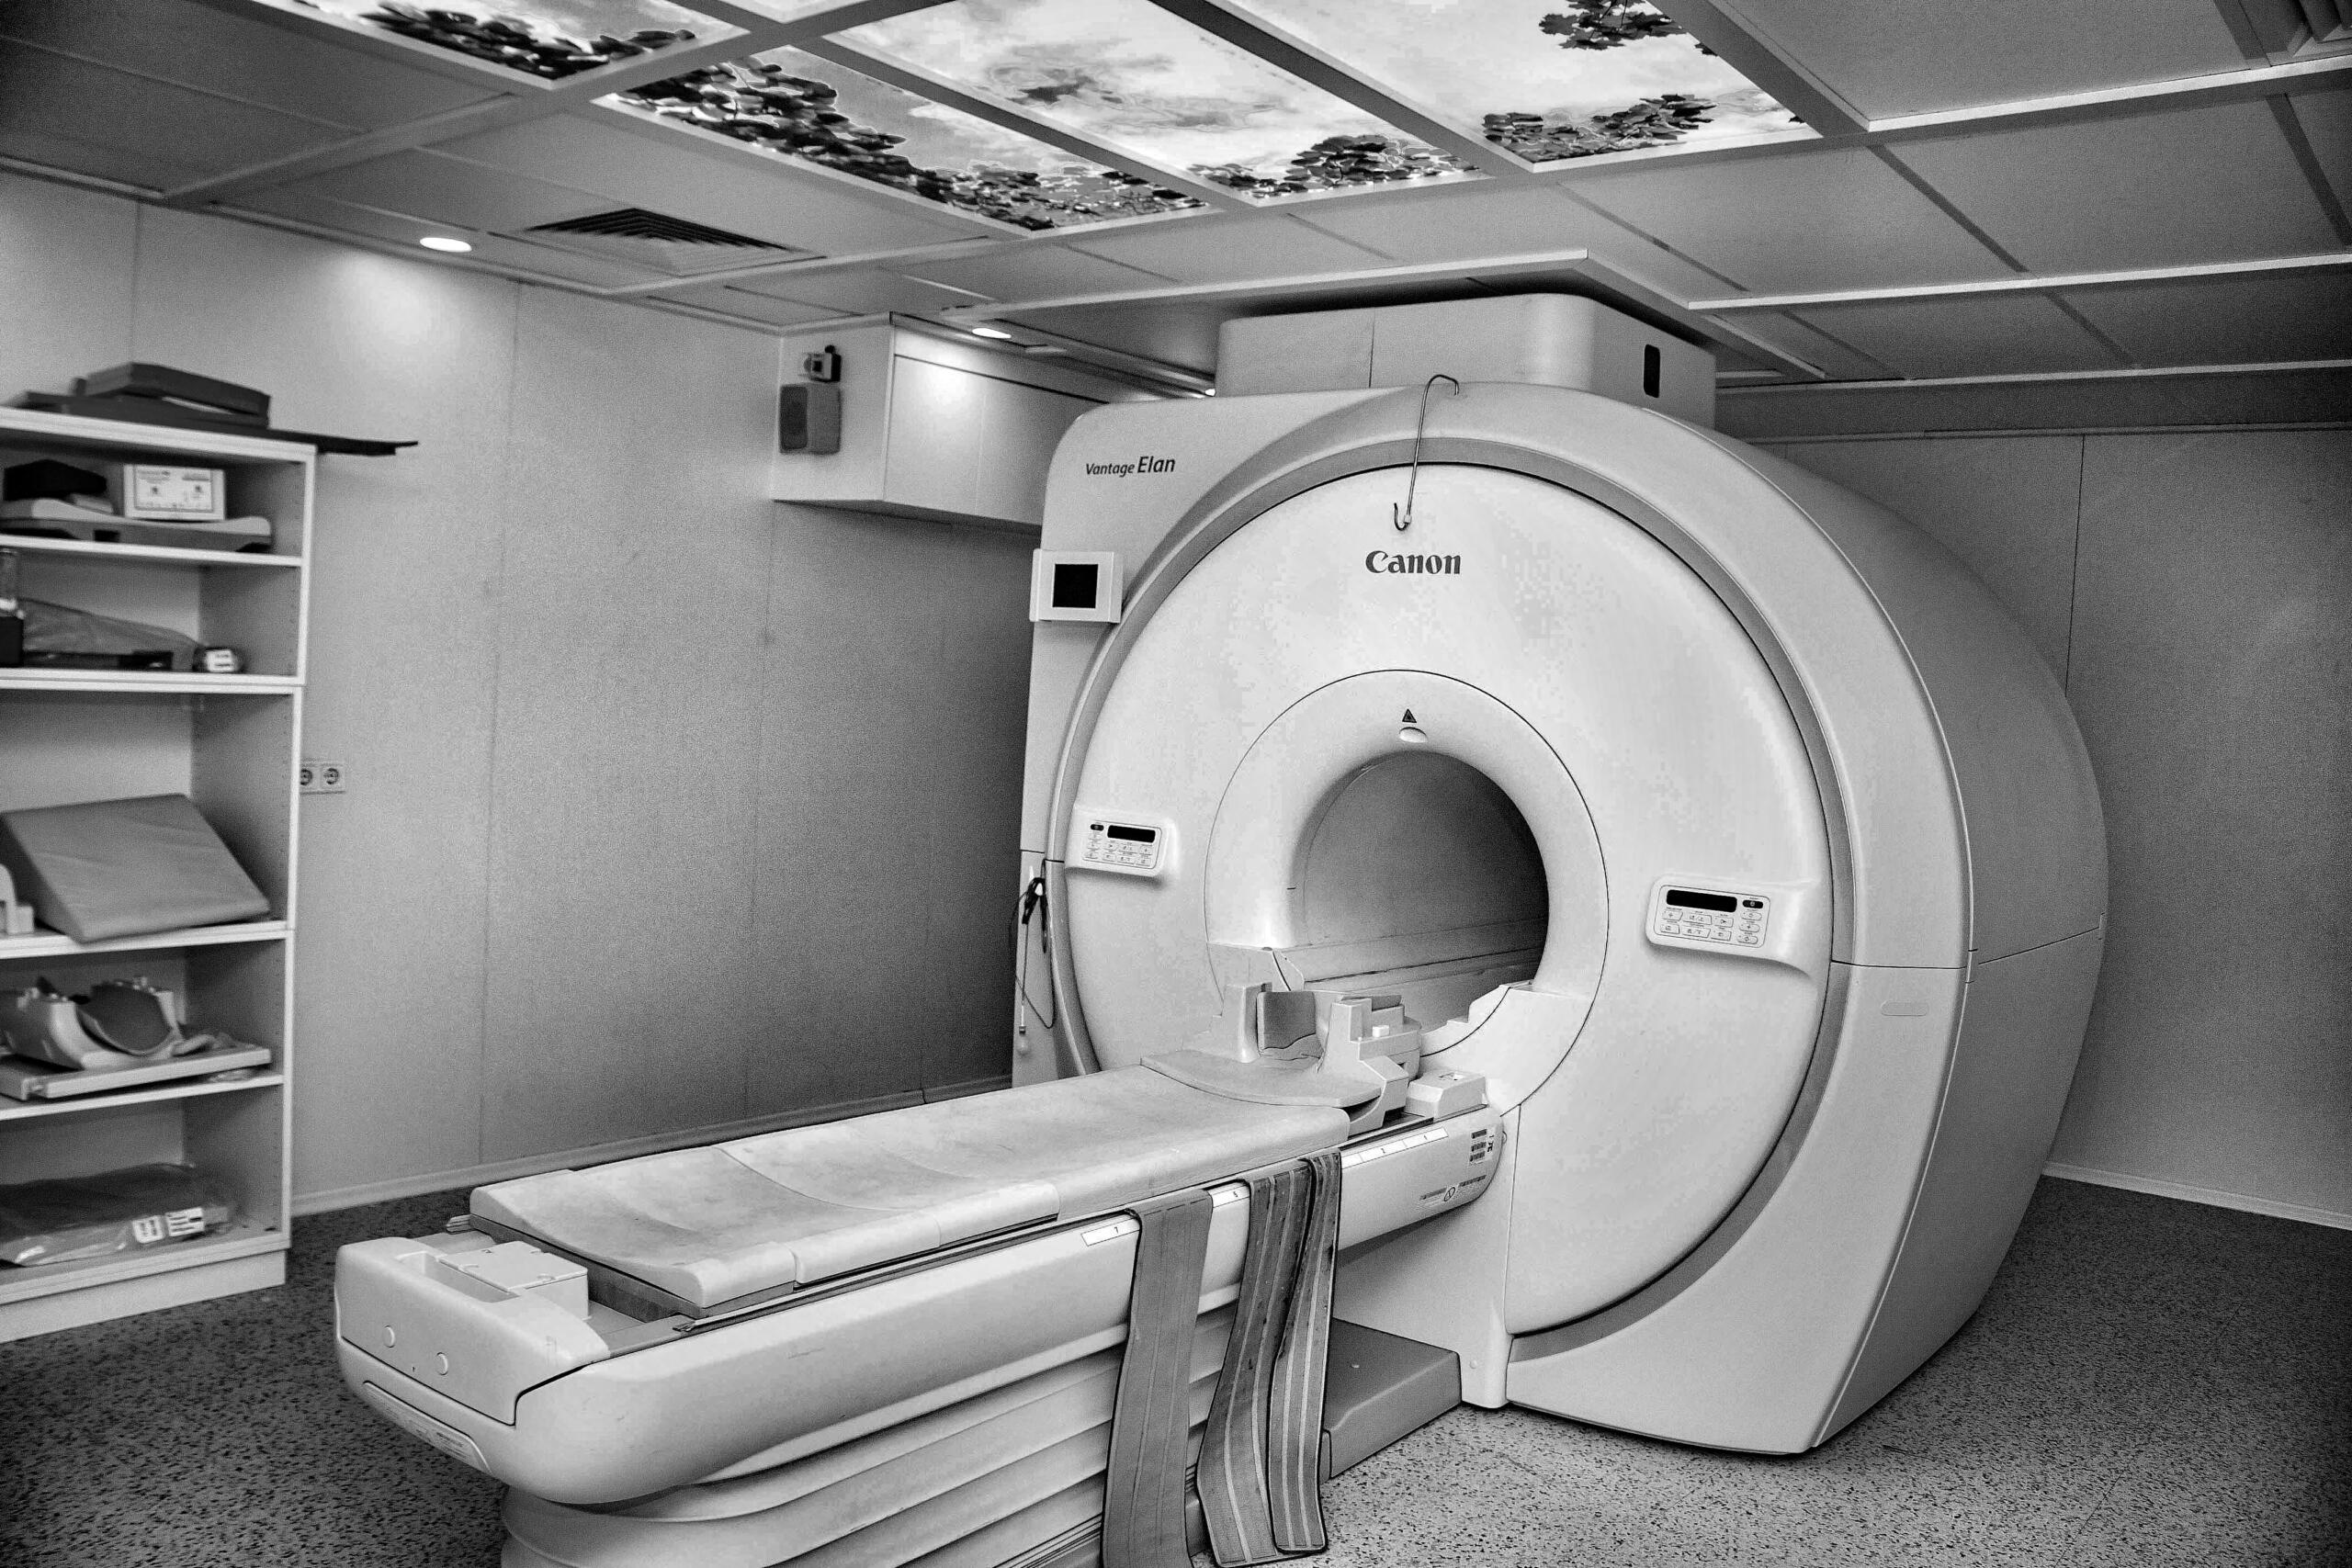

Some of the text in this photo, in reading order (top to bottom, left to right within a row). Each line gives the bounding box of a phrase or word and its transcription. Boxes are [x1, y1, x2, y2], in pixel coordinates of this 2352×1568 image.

[1086, 456, 1175, 478] Vantage Elan
[1365, 550, 1461, 574] Canon
